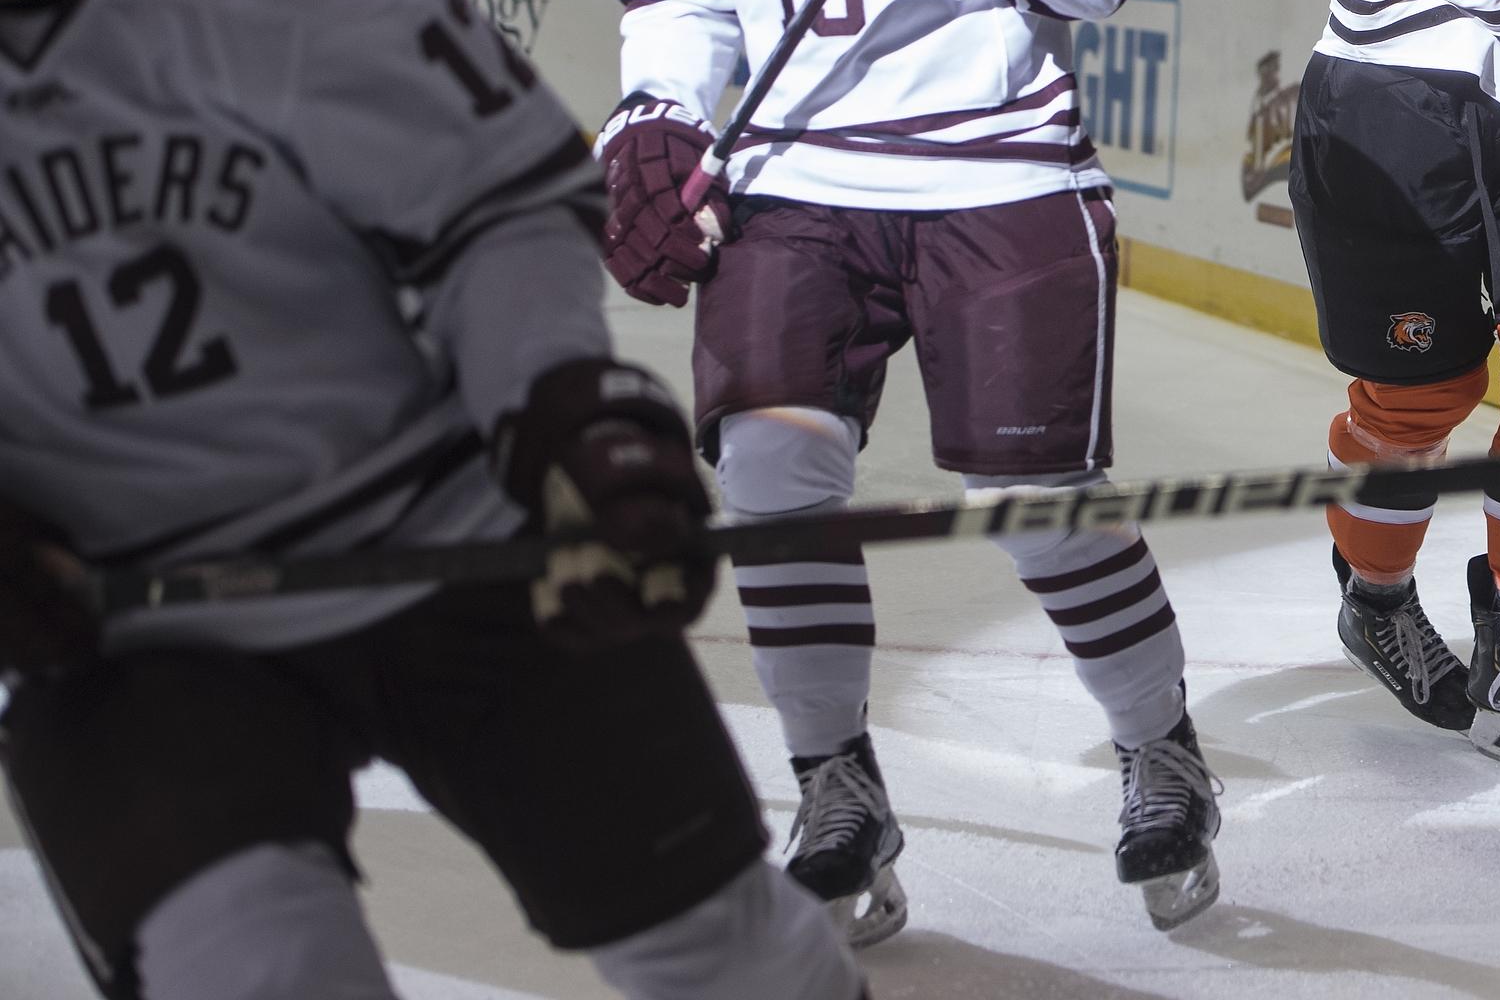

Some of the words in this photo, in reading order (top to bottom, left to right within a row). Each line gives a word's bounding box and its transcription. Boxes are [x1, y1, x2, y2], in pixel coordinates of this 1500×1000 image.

[0, 134, 266, 281] AIDERS
[43, 247, 240, 412] 12
[995, 424, 1047, 437] BAUER
[1002, 463, 1370, 536] BAUER
